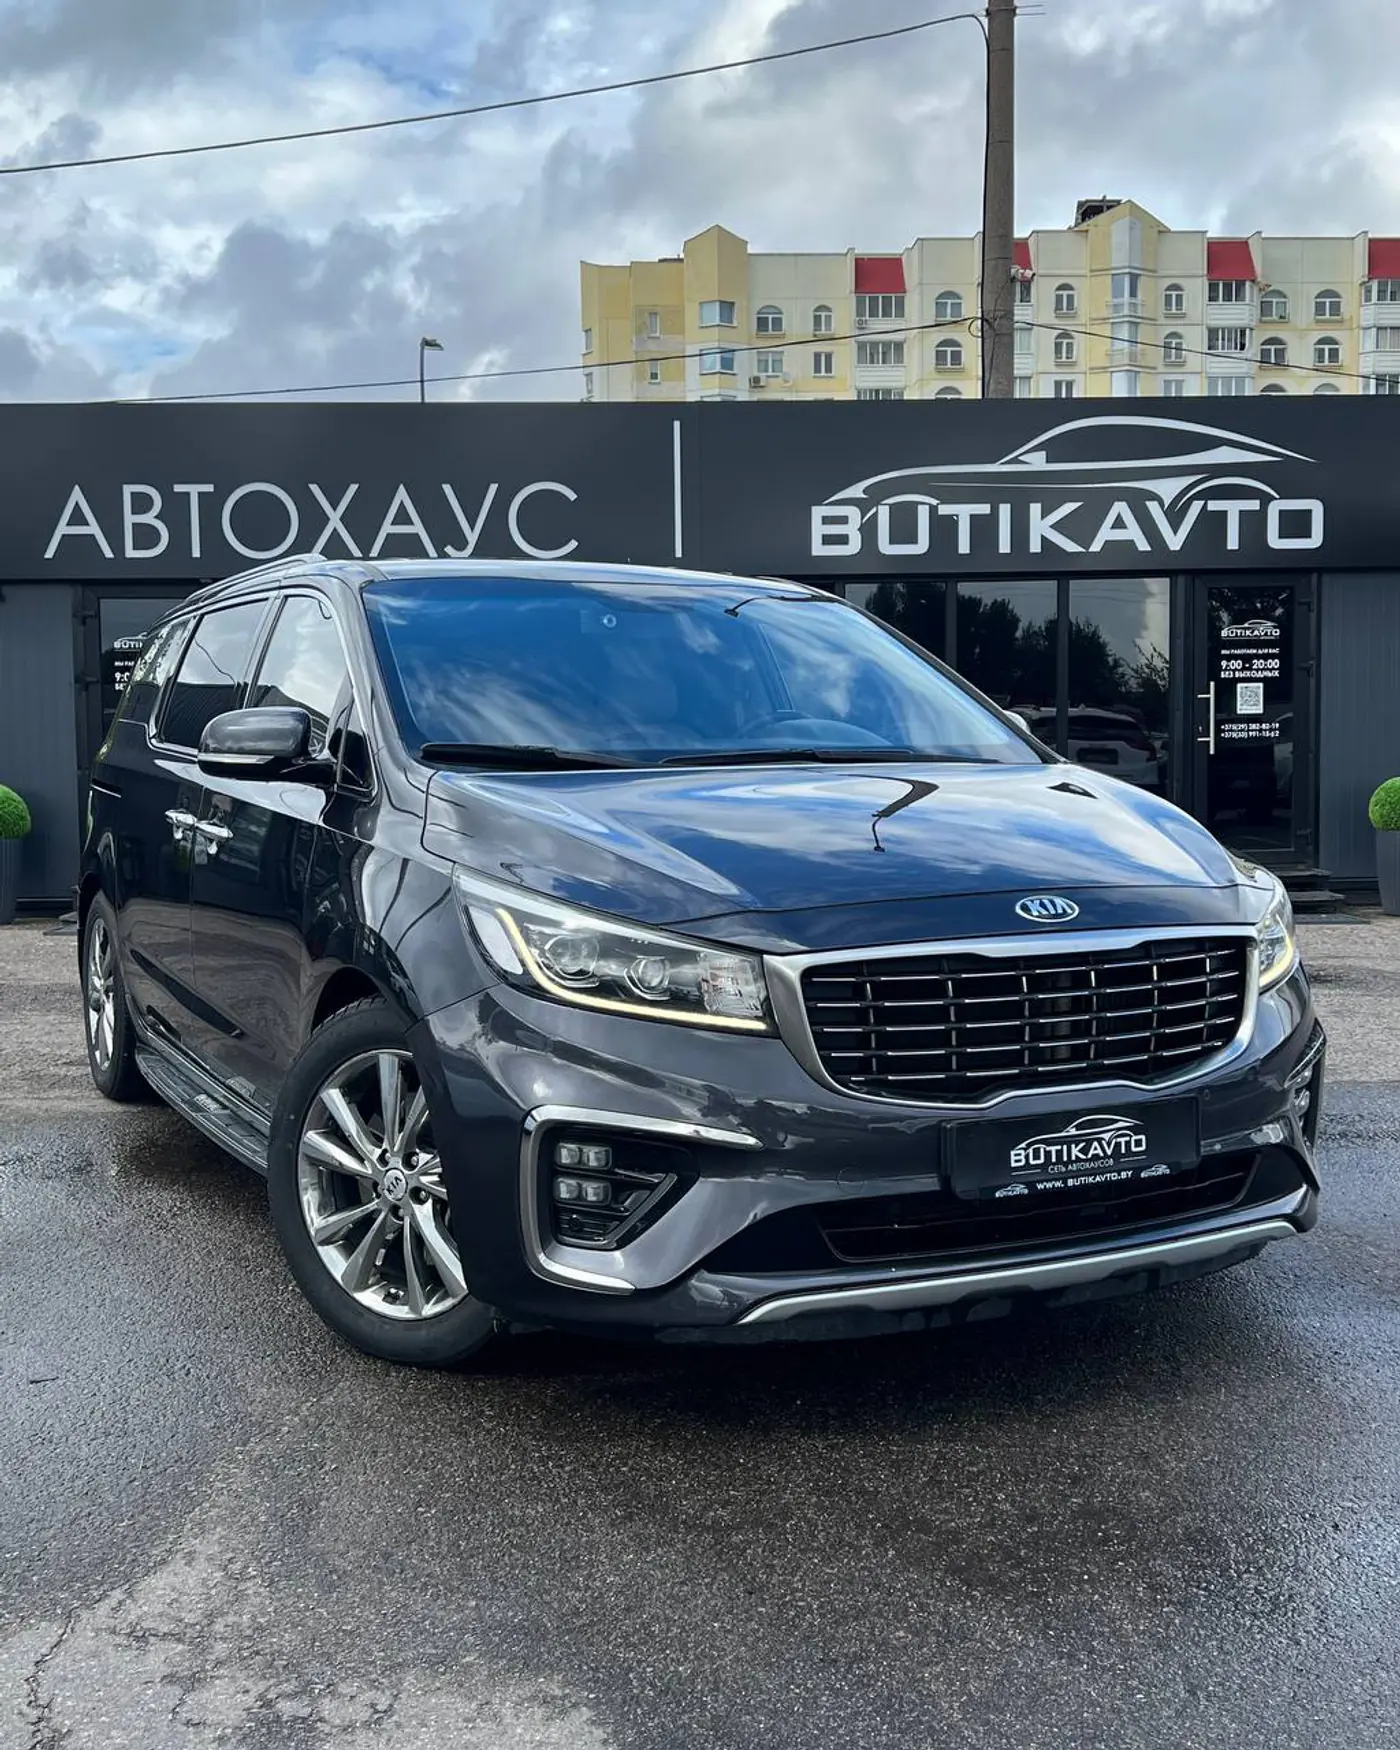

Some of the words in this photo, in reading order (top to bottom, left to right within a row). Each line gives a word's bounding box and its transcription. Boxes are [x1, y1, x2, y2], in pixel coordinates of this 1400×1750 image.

[44, 482, 579, 559] АВТОХАУС
[811, 498, 1324, 556] BUTIKAVTO
[1220, 628, 1280, 637] BUTIKAVTO
[1221, 660, 1243, 670] 9:00
[1252, 659, 1280, 669] 20:00
[1235, 670, 1280, 678] ВЫХОДНЫХ
[1025, 898, 1073, 916] KIA
[1010, 1135, 1146, 1168] BUTIKAVTO
[386, 1176, 403, 1196] KIA
[1067, 1171, 1134, 1186] BUTIKAVTO.BY
